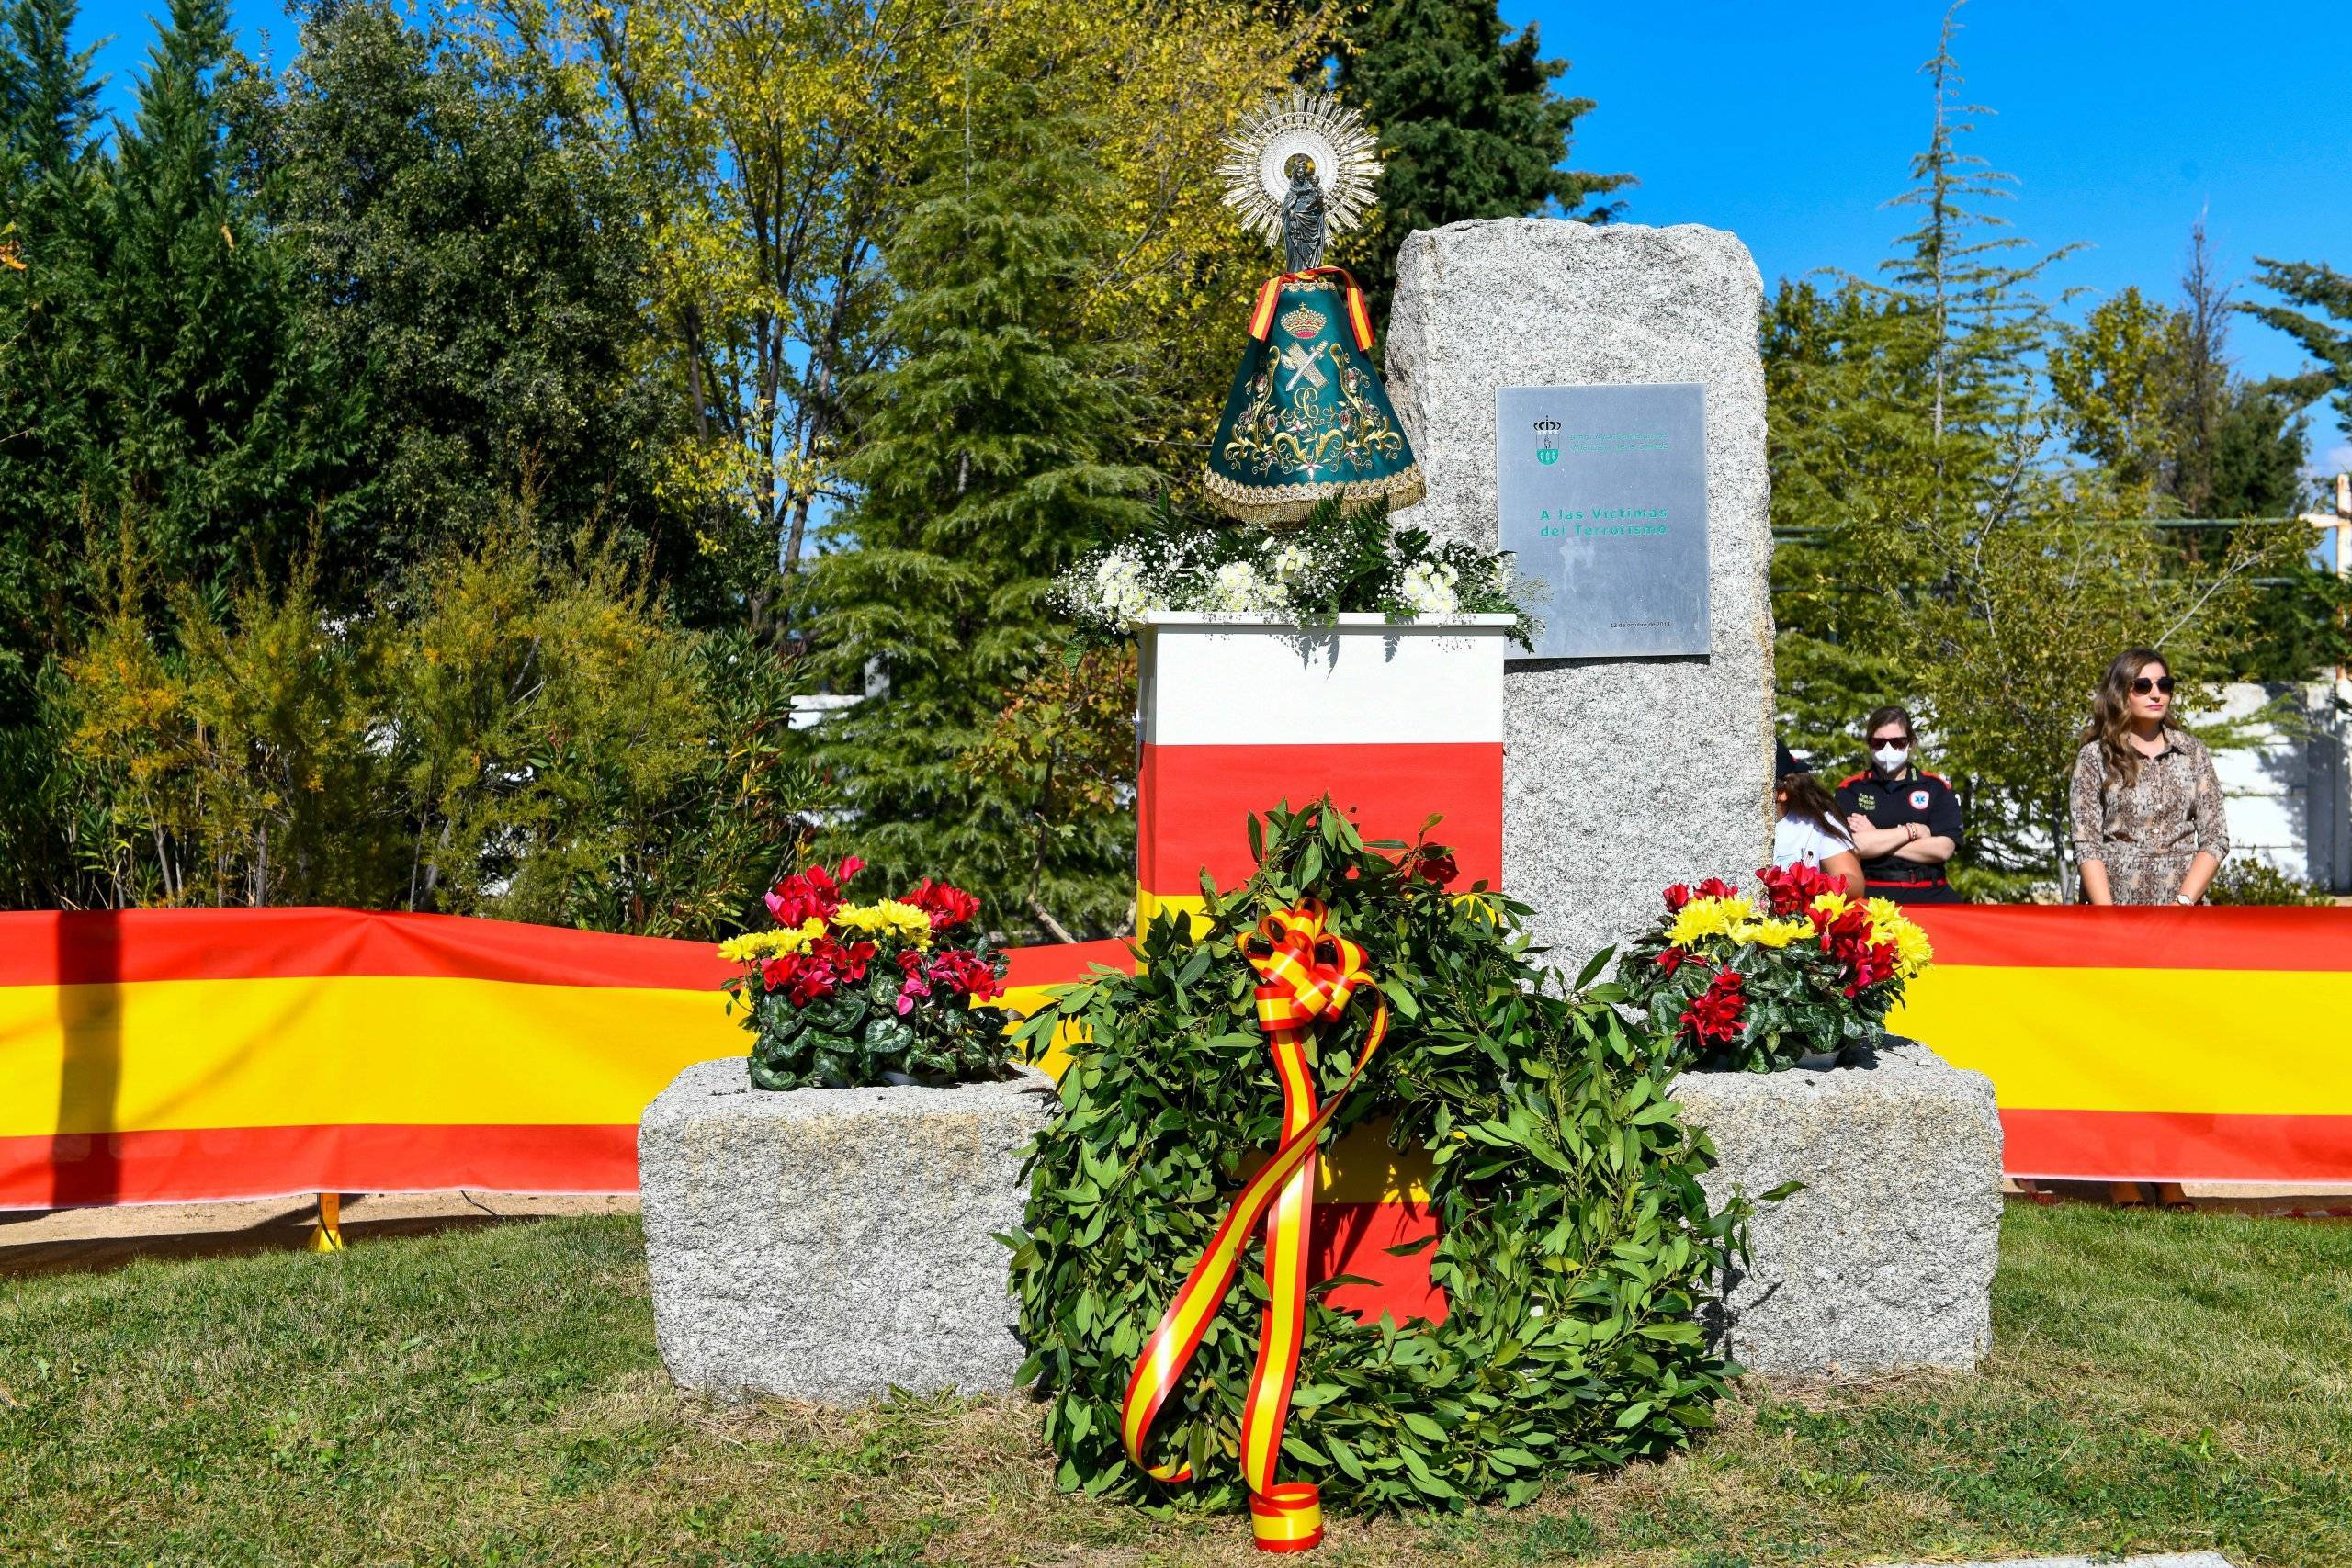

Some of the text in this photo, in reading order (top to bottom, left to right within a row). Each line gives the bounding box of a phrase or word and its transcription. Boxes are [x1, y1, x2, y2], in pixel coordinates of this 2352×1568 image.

[1541, 510, 1550, 520] A
[1559, 509, 1584, 520] las
[1541, 524, 1668, 536] del Terrorismo
